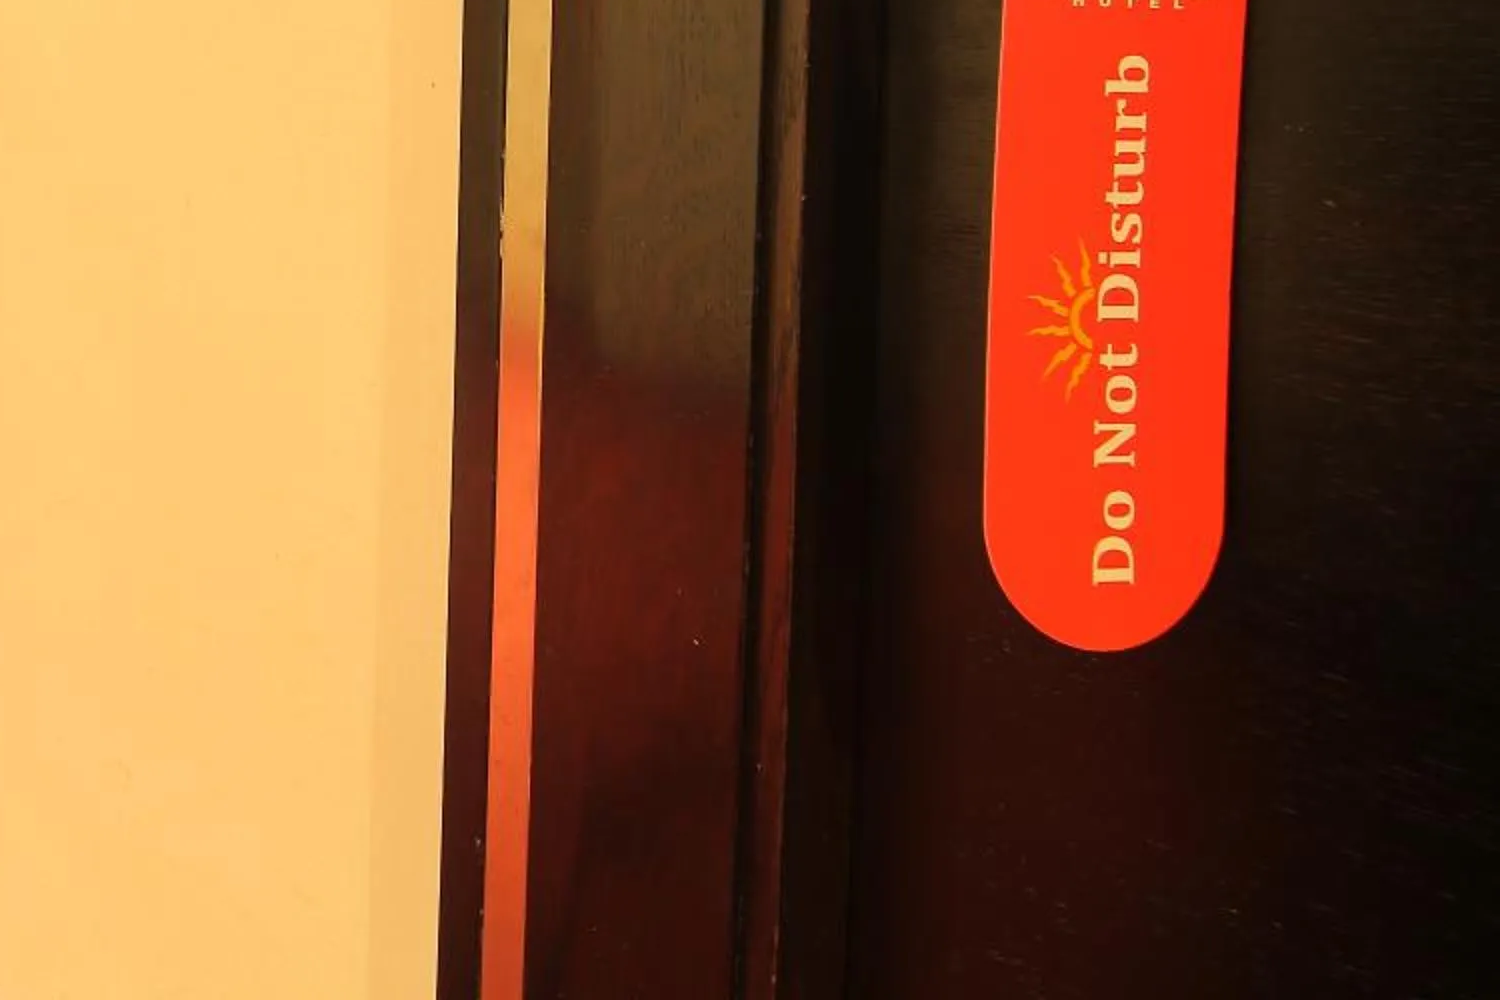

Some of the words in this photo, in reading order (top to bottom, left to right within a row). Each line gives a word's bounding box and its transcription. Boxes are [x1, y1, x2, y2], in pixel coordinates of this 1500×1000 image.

[1096, 54, 1150, 323] Disturb
[1093, 343, 1139, 468] Not
[1092, 490, 1136, 587] Do
